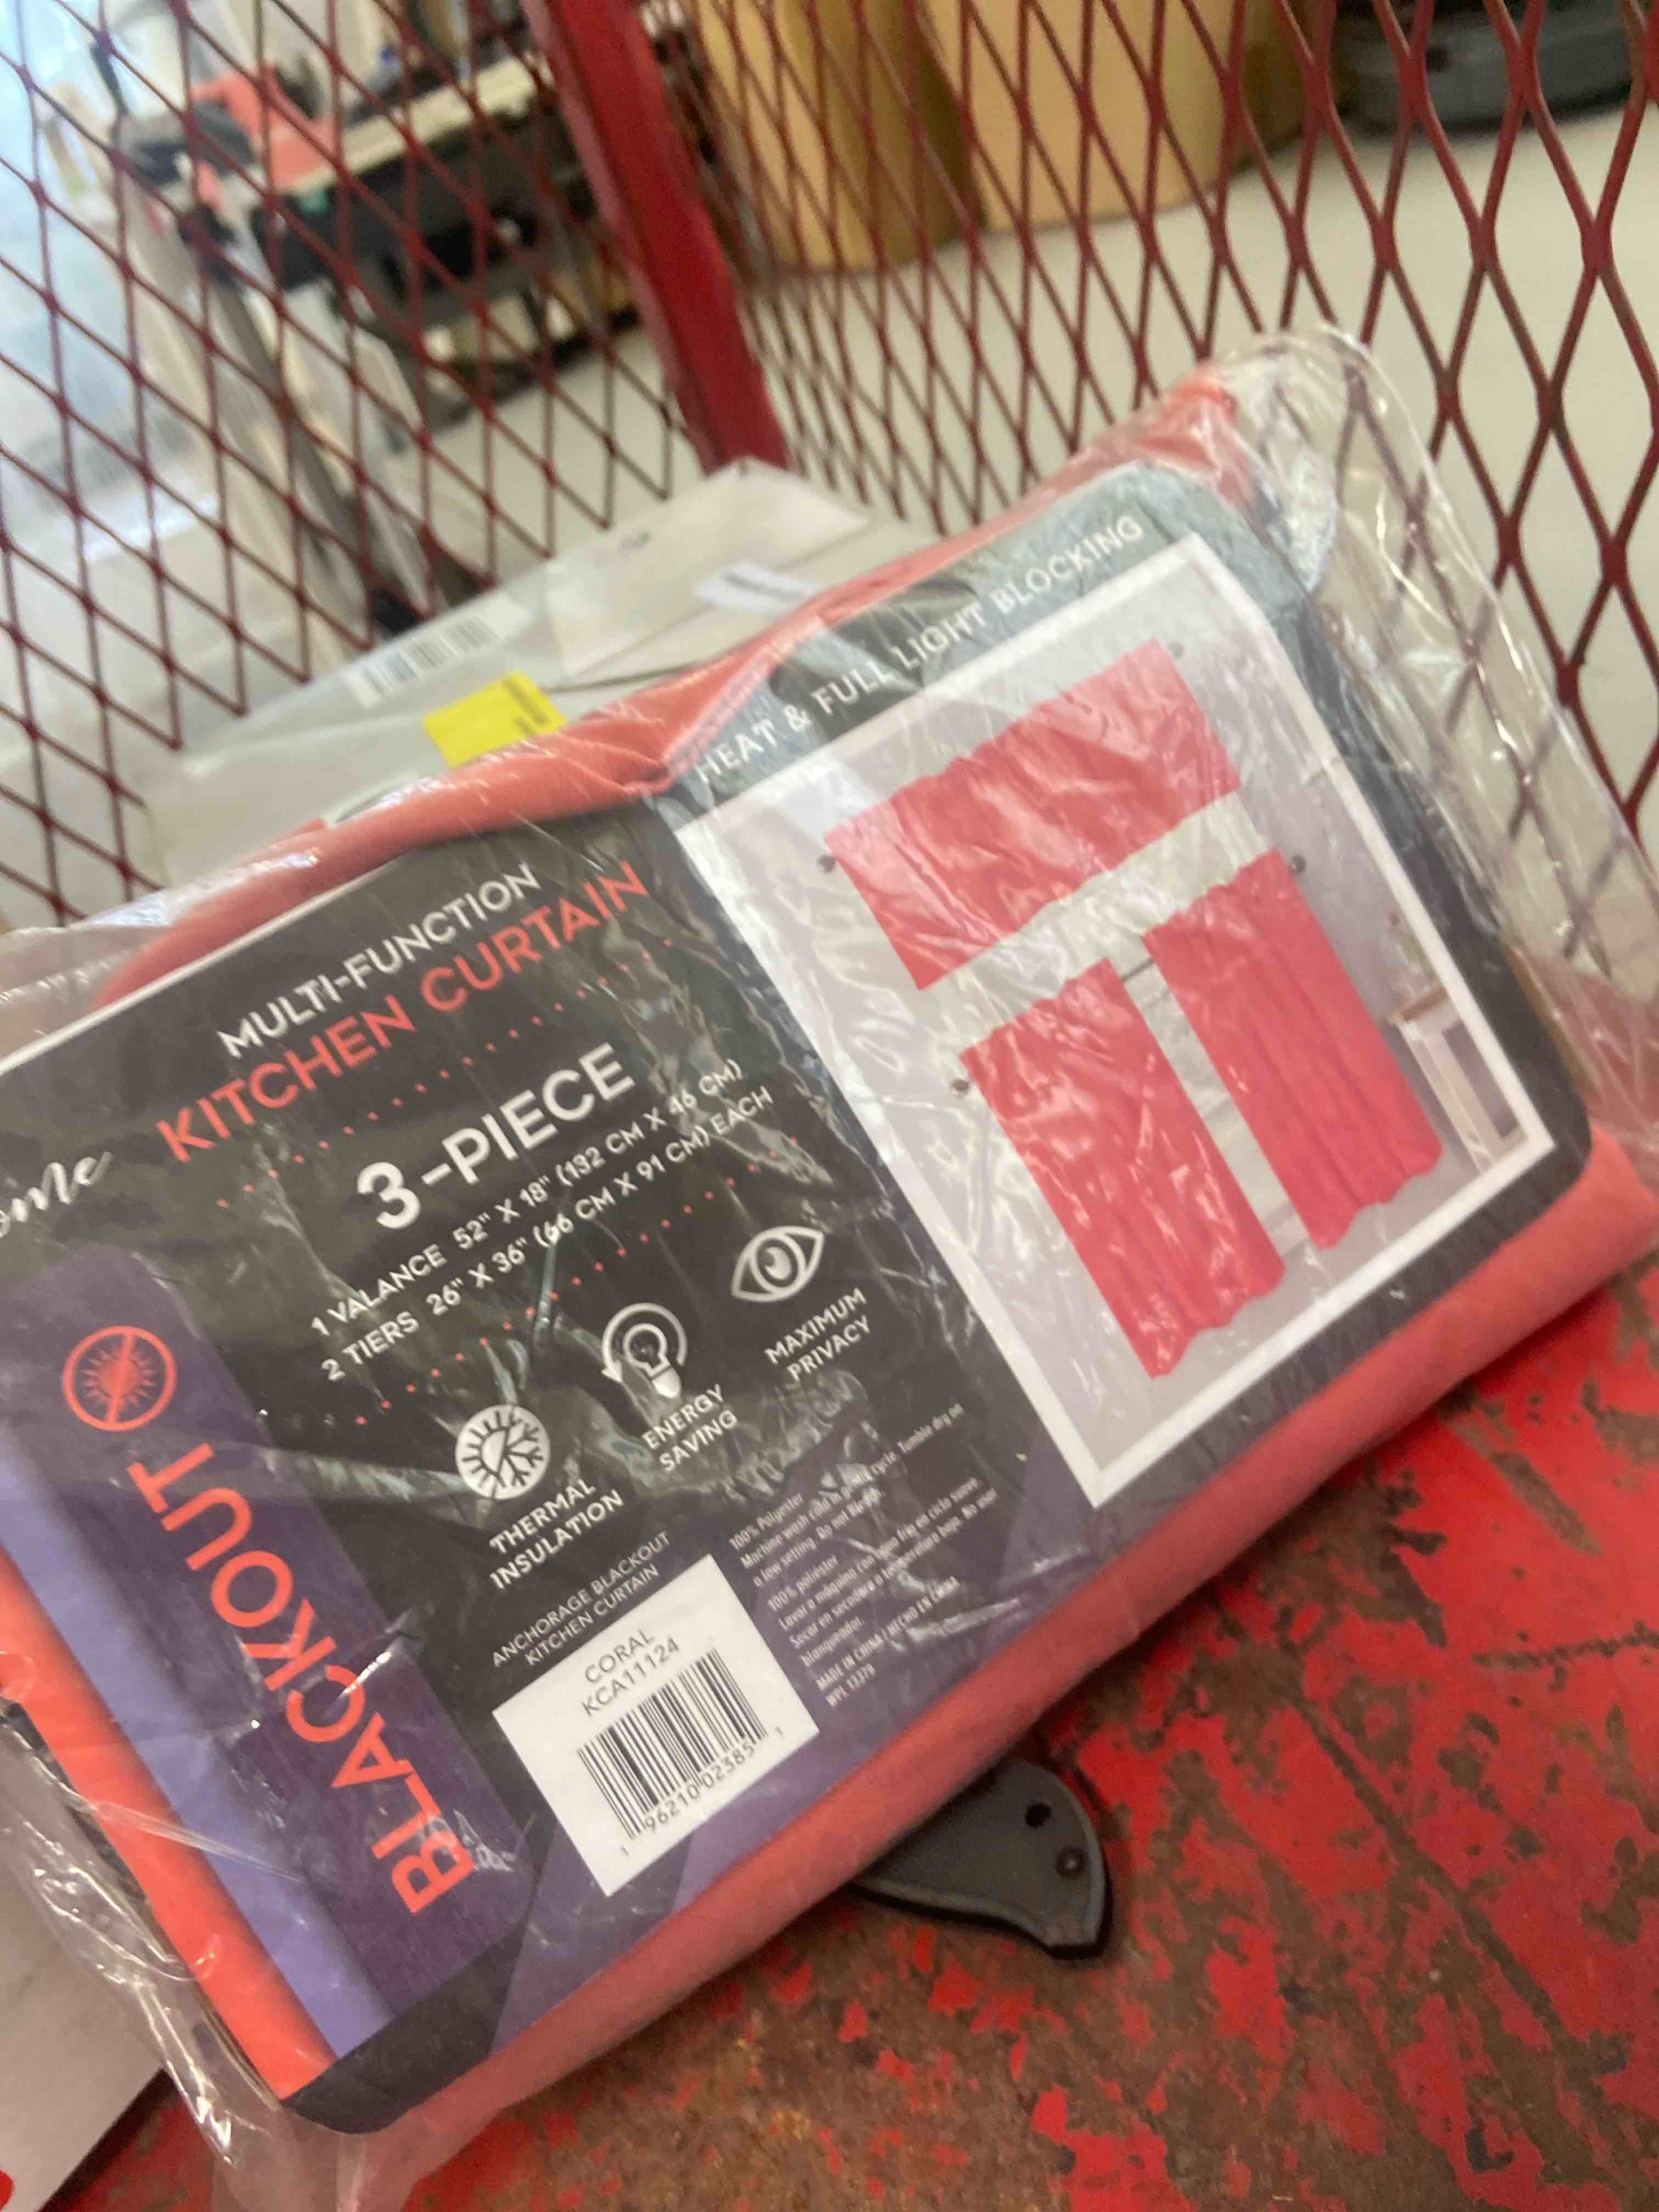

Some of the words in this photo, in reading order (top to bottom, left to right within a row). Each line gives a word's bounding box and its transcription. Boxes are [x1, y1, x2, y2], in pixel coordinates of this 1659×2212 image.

[695, 720, 777, 783] HEAT
[786, 702, 811, 732] &
[810, 662, 893, 714] FULL
[890, 603, 986, 668] LIGHT
[992, 515, 1144, 613] BLOCKING
[218, 862, 542, 1059] MULTI-FUNCTION
[157, 994, 417, 1163] KITCHEN
[421, 861, 650, 1011] CURTAIN
[357, 1042, 636, 1230] 3-PIECE
[311, 1317, 330, 1337] 1
[328, 1244, 447, 1327] VALANCE
[453, 1212, 493, 1250] 52"
[494, 1199, 521, 1224] X
[520, 1175, 551, 1209] 18"
[555, 1147, 606, 1188] (132
[606, 1122, 646, 1155] CM
[642, 1106, 666, 1131] X
[668, 1092, 697, 1116] 46
[698, 1058, 744, 1097] CM)
[320, 1358, 346, 1383] 2
[342, 1311, 420, 1365] TIERS
[425, 1277, 465, 1316] 26"
[468, 1262, 494, 1288] X
[492, 1237, 527, 1273] 36"
[533, 1211, 575, 1248] (66
[574, 1188, 616, 1222] CM
[614, 1172, 639, 1198] X
[636, 1153, 666, 1182] 91
[665, 1127, 710, 1165] CM)
[710, 1086, 776, 1133] EACH
[764, 1287, 867, 1365] MAXIMUM
[787, 1316, 872, 1382] PRIVACY
[640, 1384, 726, 1451] ENERGY
[658, 1410, 739, 1473] SAVING
[489, 1477, 597, 1555] THERMAL
[729, 1526, 760, 1550] 100%
[755, 1493, 803, 1530] Polyester
[740, 1534, 782, 1568] Machine
[782, 1515, 809, 1539] wash
[808, 1498, 832, 1521] cold
[897, 1425, 934, 1454] Tumble
[932, 1413, 952, 1431] dry
[490, 1489, 625, 1592] INSULATION
[753, 1575, 762, 1588] a
[760, 1562, 782, 1581] low
[815, 1525, 833, 1539] Do
[831, 1509, 850, 1530] not
[492, 1588, 591, 1668] ANCHORAGE
[590, 1531, 672, 1595] BLACKOUT
[524, 1613, 594, 1666] KITCHEN
[593, 1564, 660, 1617] CURTAIN
[768, 1585, 798, 1611] 100%
[777, 1604, 808, 1631] Lavar
[806, 1599, 817, 1610] a
[856, 1554, 877, 1573] con
[789, 1622, 820, 1650] Secar
[817, 1612, 833, 1628] en
[127, 1442, 474, 1914] BLACKOUT
[582, 1637, 680, 1716] KCA11124
[584, 1629, 654, 1684] CORAL
[816, 1663, 844, 1691] MADE
[841, 1654, 856, 1671] IN
[853, 1633, 884, 1662] CHINA
[886, 1606, 919, 1636] HECHO
[916, 1596, 932, 1613] EN
[644, 1785, 701, 1833] 96210
[701, 1741, 758, 1790] 02385
